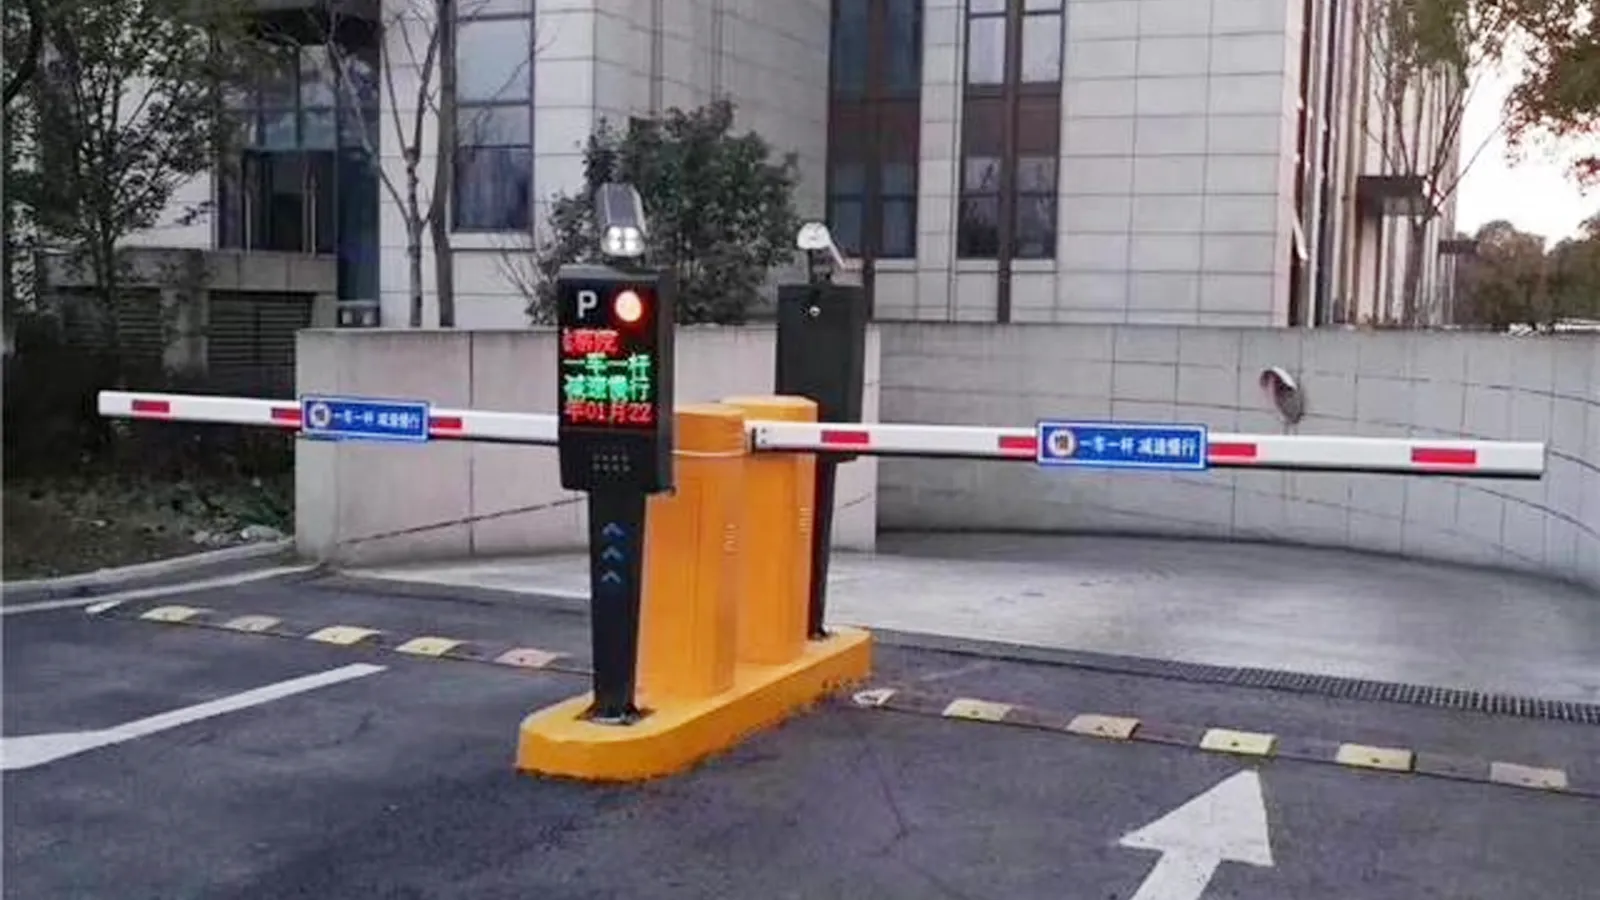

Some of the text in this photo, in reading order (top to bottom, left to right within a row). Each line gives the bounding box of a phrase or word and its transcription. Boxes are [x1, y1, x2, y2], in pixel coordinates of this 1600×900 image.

[577, 290, 598, 319] P
[563, 352, 650, 382] 一车一杆
[563, 374, 650, 402] 减速慢行
[1079, 436, 1134, 455] 一车一杆
[1138, 437, 1196, 457] 减速慢行
